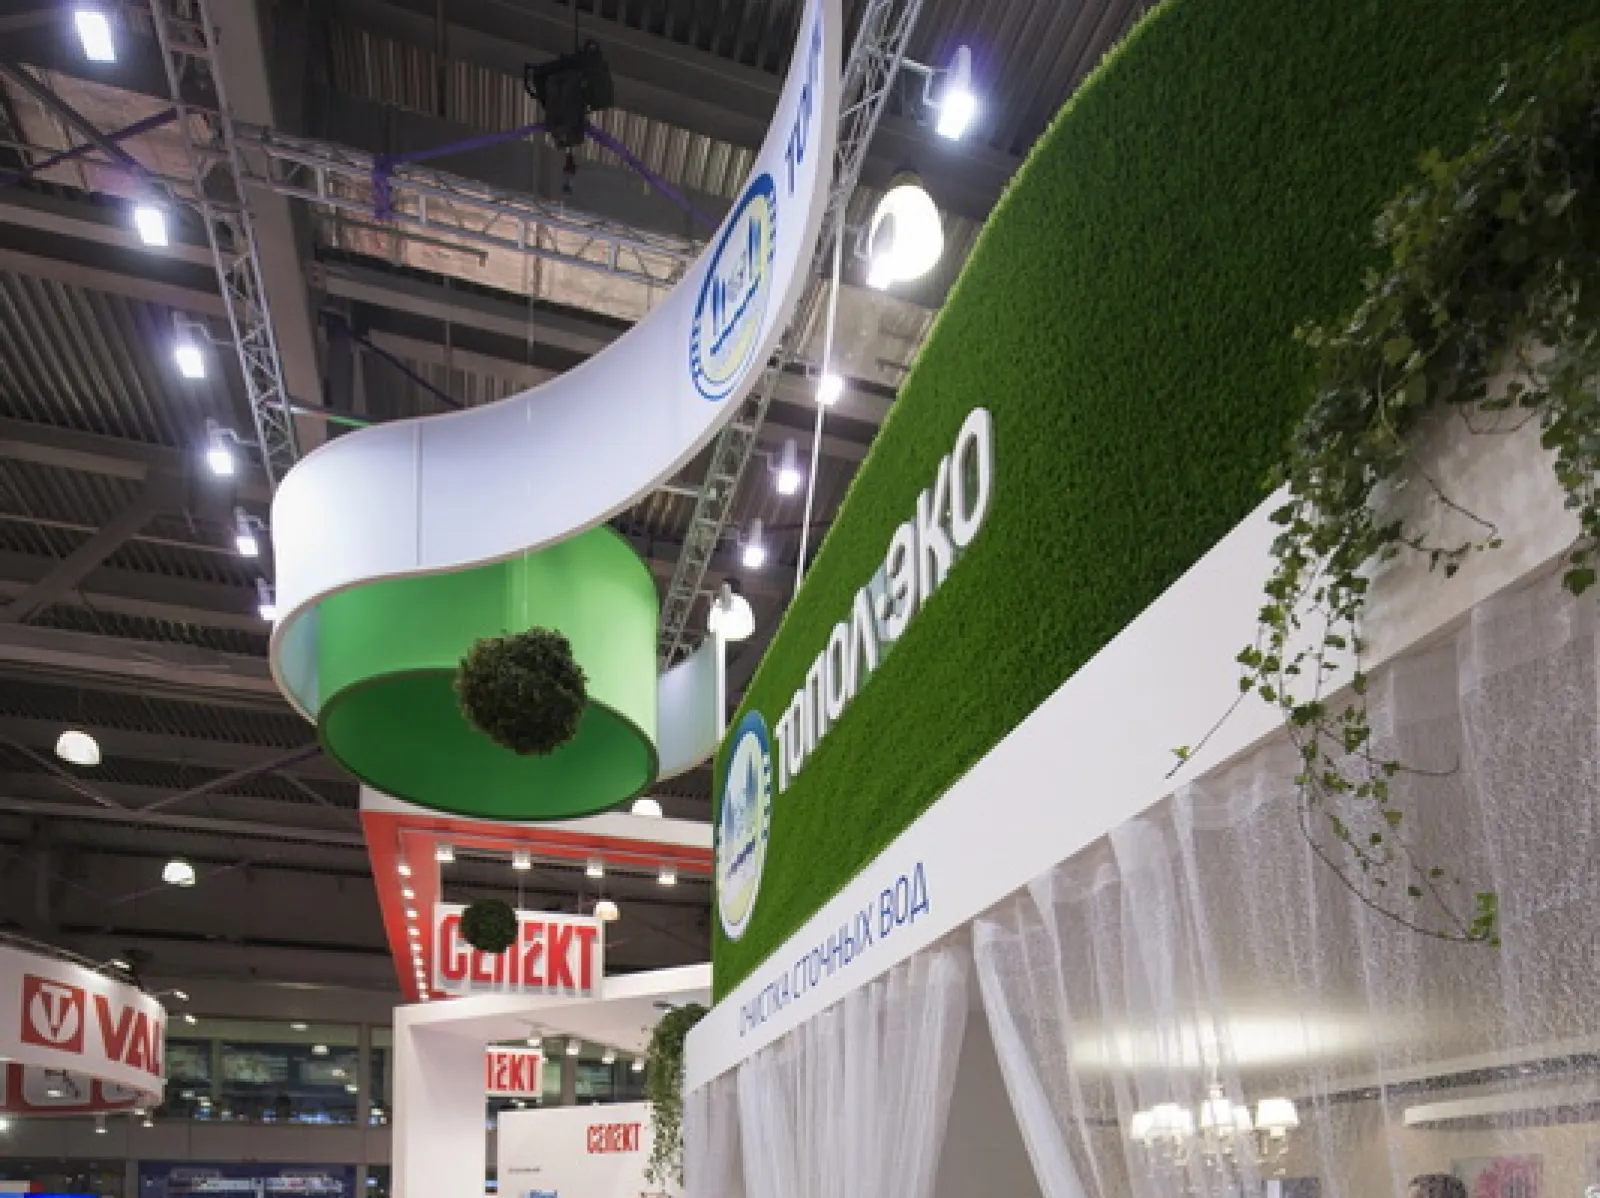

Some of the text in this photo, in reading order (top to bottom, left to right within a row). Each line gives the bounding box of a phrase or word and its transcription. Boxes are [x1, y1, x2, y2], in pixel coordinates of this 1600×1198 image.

[739, 862, 930, 1038] ОЧИСТКА СТОЧНЫХ ВОД
